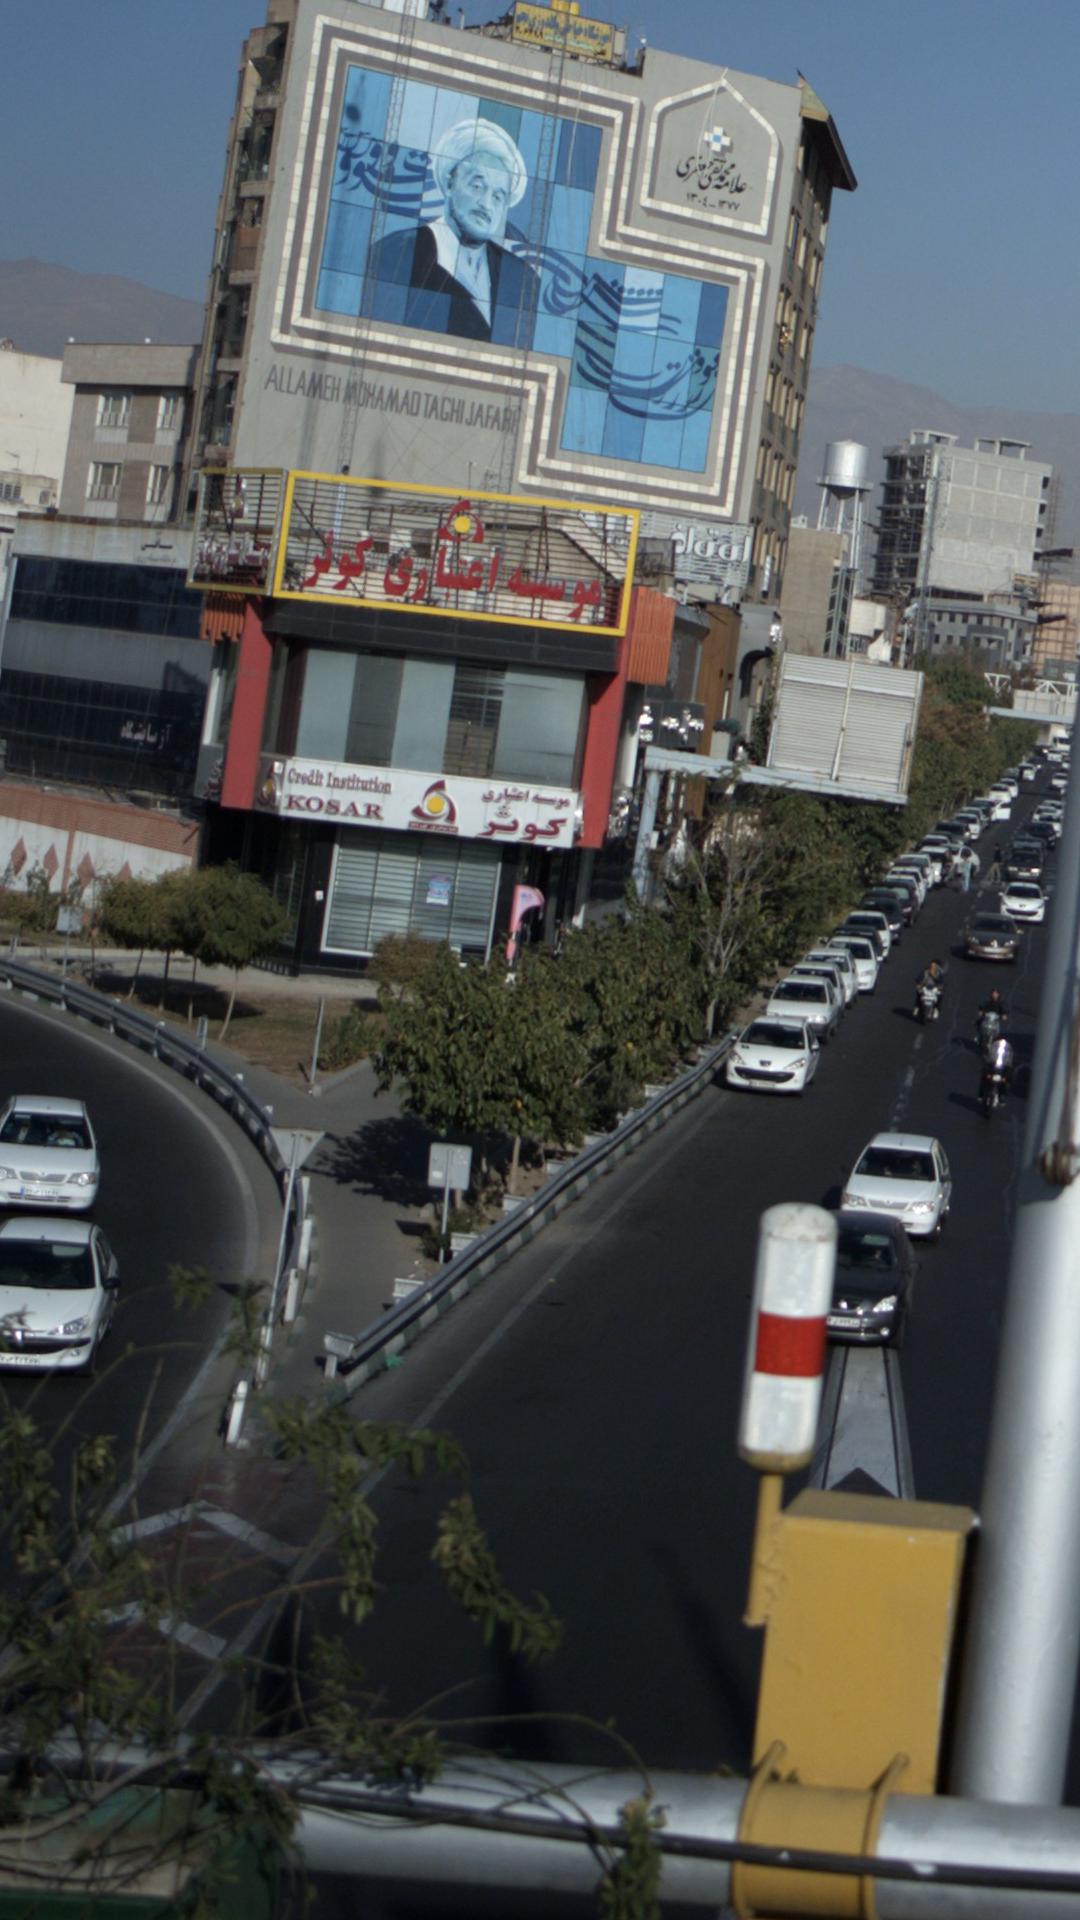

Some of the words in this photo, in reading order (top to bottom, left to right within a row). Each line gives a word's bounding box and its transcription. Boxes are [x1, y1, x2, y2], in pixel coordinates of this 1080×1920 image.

[264, 364, 341, 403] ALLAMEH
[343, 377, 422, 417] MOHAMAD
[424, 393, 466, 424] TAGHI
[303, 530, 374, 589] کوثر
[287, 766, 324, 787] Credit
[327, 771, 393, 794] Institution
[285, 794, 384, 820] KOSAR
[481, 786, 530, 806] اعتباری
[532, 791, 571, 809] موسسه
[475, 803, 568, 842] کوثر
